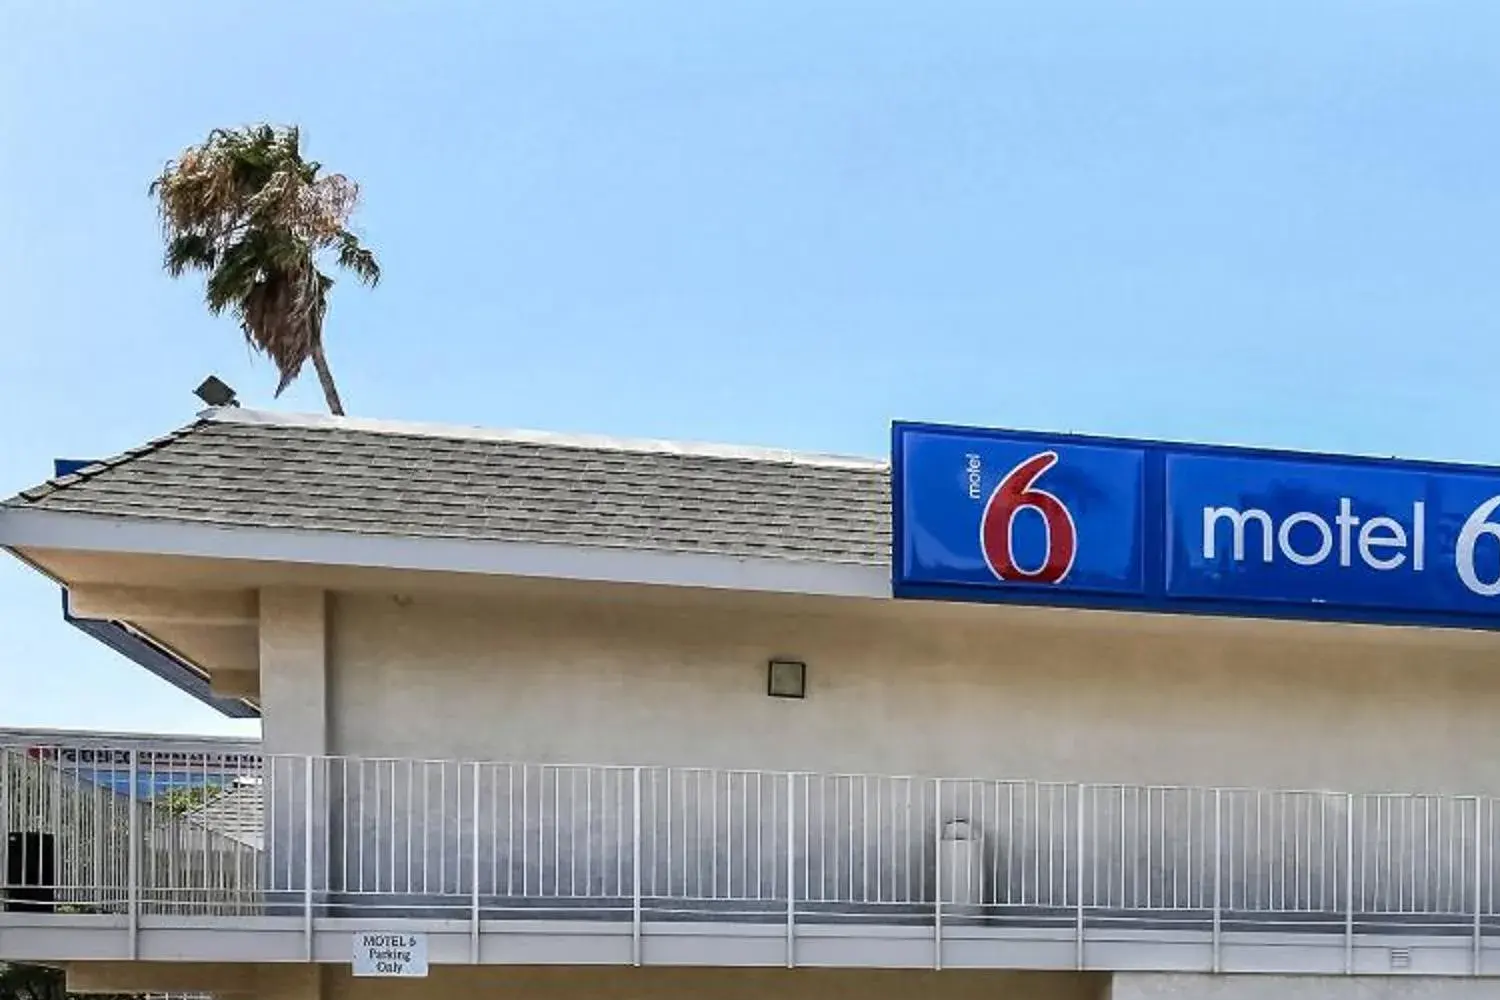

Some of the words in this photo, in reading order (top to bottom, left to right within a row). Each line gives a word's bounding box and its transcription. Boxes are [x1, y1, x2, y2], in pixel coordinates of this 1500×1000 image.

[966, 453, 981, 499] motel
[979, 450, 1077, 585] 6
[1203, 497, 1424, 571] motel
[363, 935, 406, 947] MOTEL
[369, 948, 411, 962] Parking
[376, 961, 403, 974] Only
